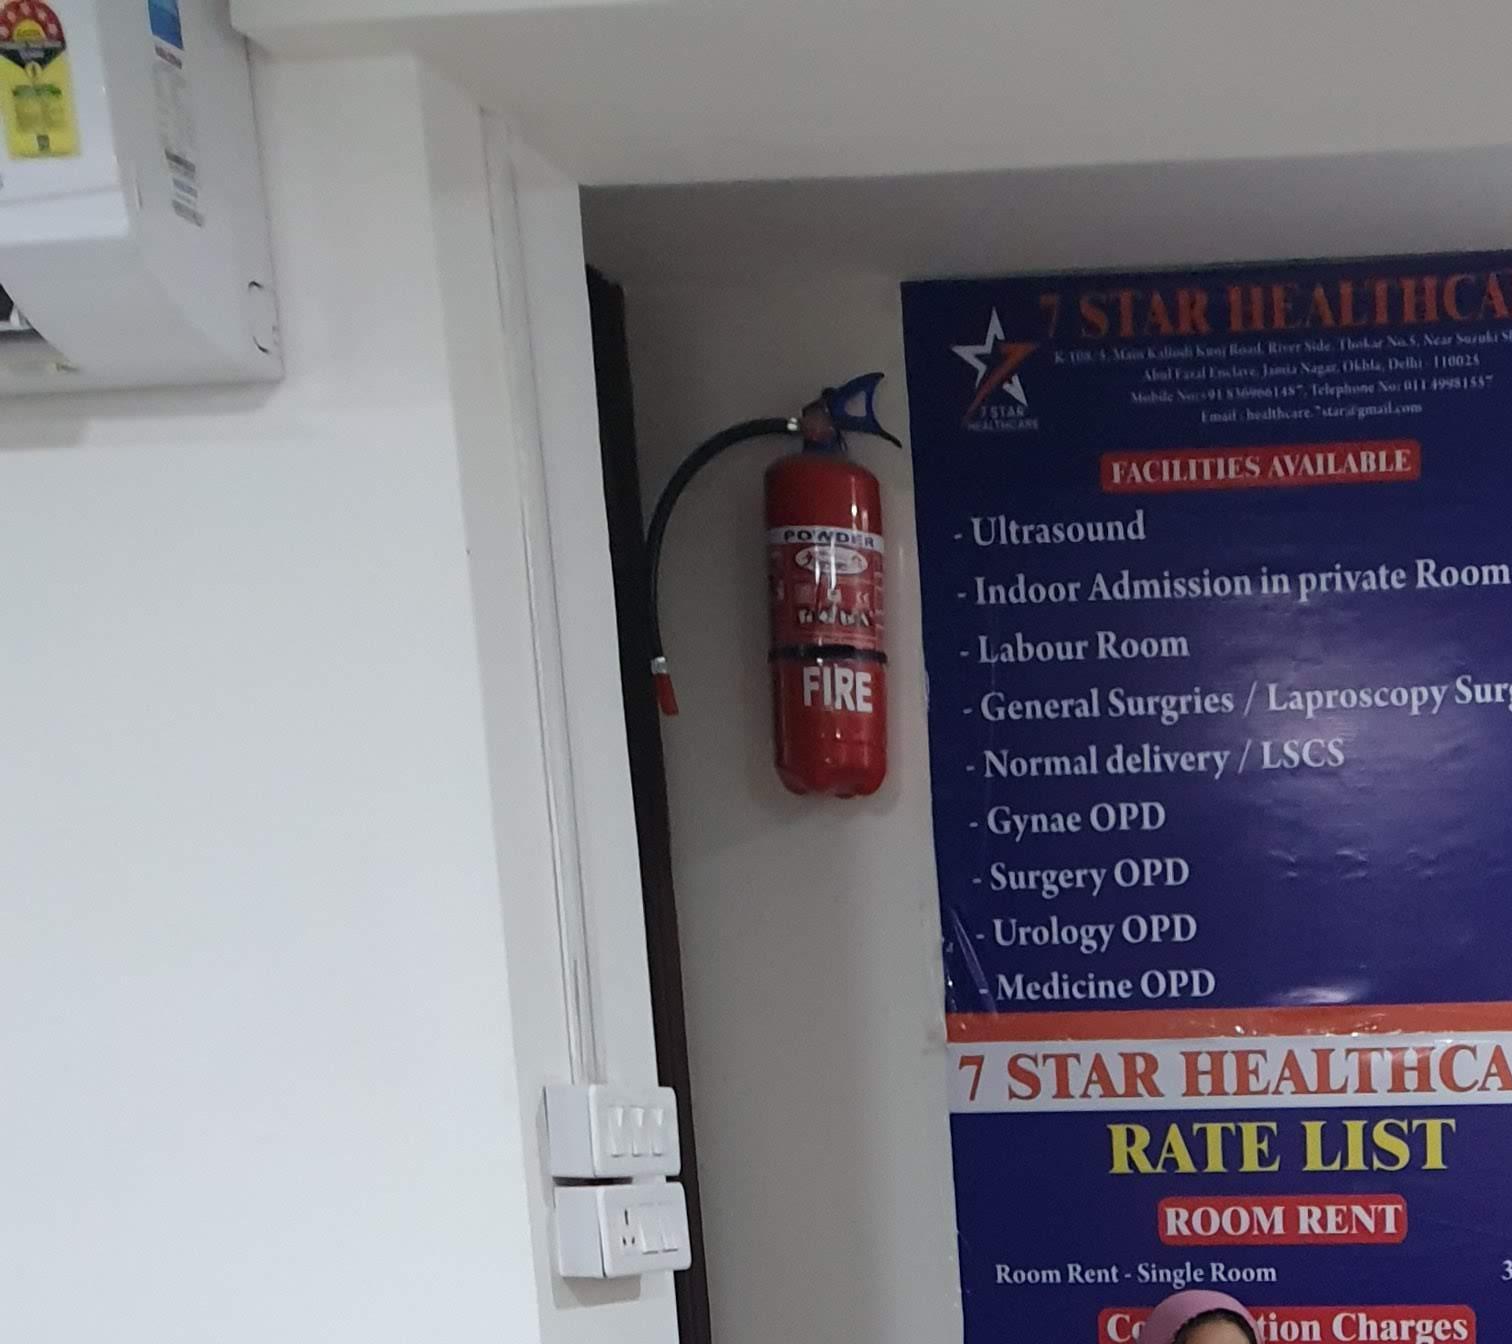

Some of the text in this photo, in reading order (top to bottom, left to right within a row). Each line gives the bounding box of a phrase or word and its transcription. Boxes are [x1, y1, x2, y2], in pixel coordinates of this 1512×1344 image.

[1038, 294, 1059, 339] 7
[1079, 287, 1212, 339] STAR
[1268, 340, 1301, 354] River
[1424, 333, 1453, 347] Near
[1456, 330, 1498, 345] Suzuki
[1263, 362, 1297, 377] Jamia
[1388, 356, 1422, 370] Delhi
[1434, 353, 1480, 369] 110025
[1130, 390, 1173, 404] Mobile
[1312, 381, 1375, 400] Telephone
[1404, 377, 1426, 392] 011
[990, 405, 1025, 419] STAR
[1201, 407, 1237, 424] Email
[1110, 448, 1413, 485] FACILITIES AVAILABLE
[970, 510, 1147, 547] Ultrasound
[975, 574, 1082, 606] Indoor
[1088, 568, 1251, 602] Admission
[1260, 566, 1291, 598] in
[1299, 564, 1406, 609] private
[1414, 560, 1511, 591] Room
[978, 633, 1089, 664] Labour
[1097, 631, 1190, 661] Room
[803, 666, 873, 714] FIRE
[981, 688, 1100, 722] General
[1108, 686, 1234, 729] Surgries
[1267, 681, 1447, 719] Laproscopy
[984, 746, 1098, 779] Normal
[1105, 743, 1231, 784] delivery
[1260, 738, 1345, 771] LSCS
[986, 804, 1082, 843] Gynae
[1089, 801, 1167, 832] OPD
[989, 859, 1106, 898] Surgery
[1113, 857, 1190, 888] OPD
[992, 914, 1115, 953] Urology
[1121, 913, 1198, 944] OPD
[996, 968, 1134, 1002] Medicine
[1140, 968, 1216, 999] OPD
[958, 1055, 985, 1101] 7
[1007, 1052, 1165, 1101] STAR
[1106, 1118, 1457, 1175] RATE LIST
[1165, 1204, 1404, 1237] ROOM RENT
[995, 1264, 1062, 1284] Room
[1066, 1263, 1119, 1284] Rent
[1137, 1261, 1204, 1289] Single
[1209, 1262, 1277, 1282] Room
